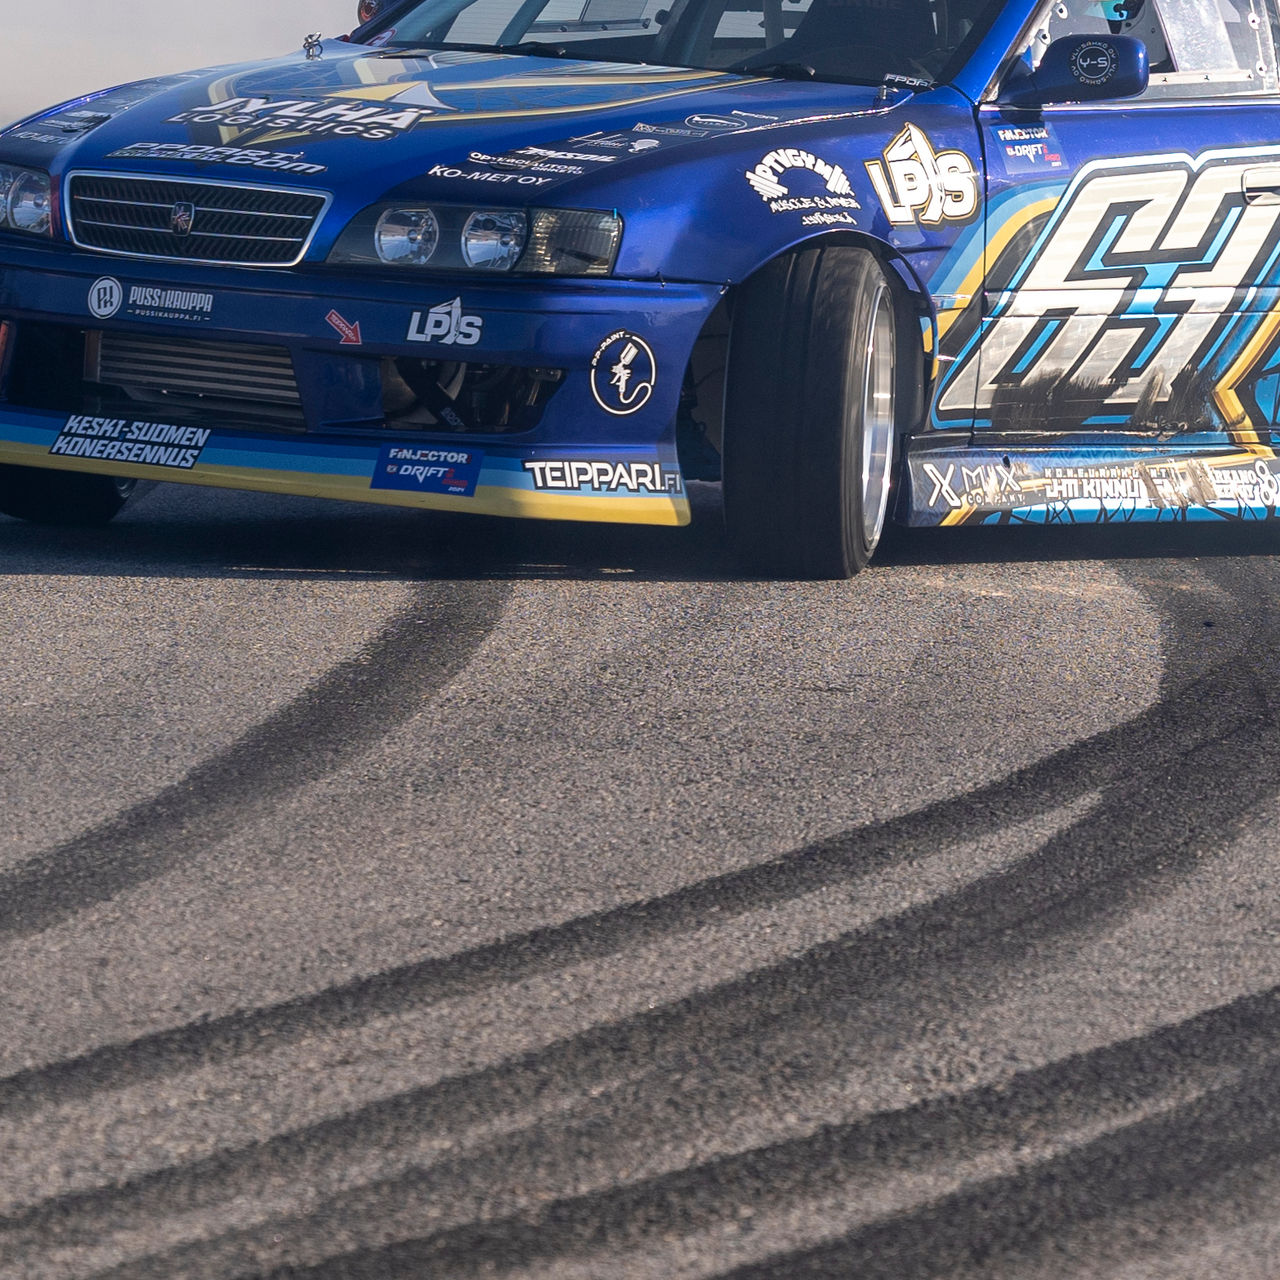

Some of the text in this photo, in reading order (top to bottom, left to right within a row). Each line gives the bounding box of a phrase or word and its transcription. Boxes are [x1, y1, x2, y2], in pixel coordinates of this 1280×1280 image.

[1080, 57, 1108, 68] Y-S
[168, 112, 393, 139] LOGISTICS
[193, 98, 433, 130] JYLHÄ
[128, 286, 214, 312] PUSSIKAUPPA
[63, 414, 211, 447] KESKI-SUOMEN
[51, 435, 200, 468] KONEASENNUS
[399, 464, 449, 484] DRIFT
